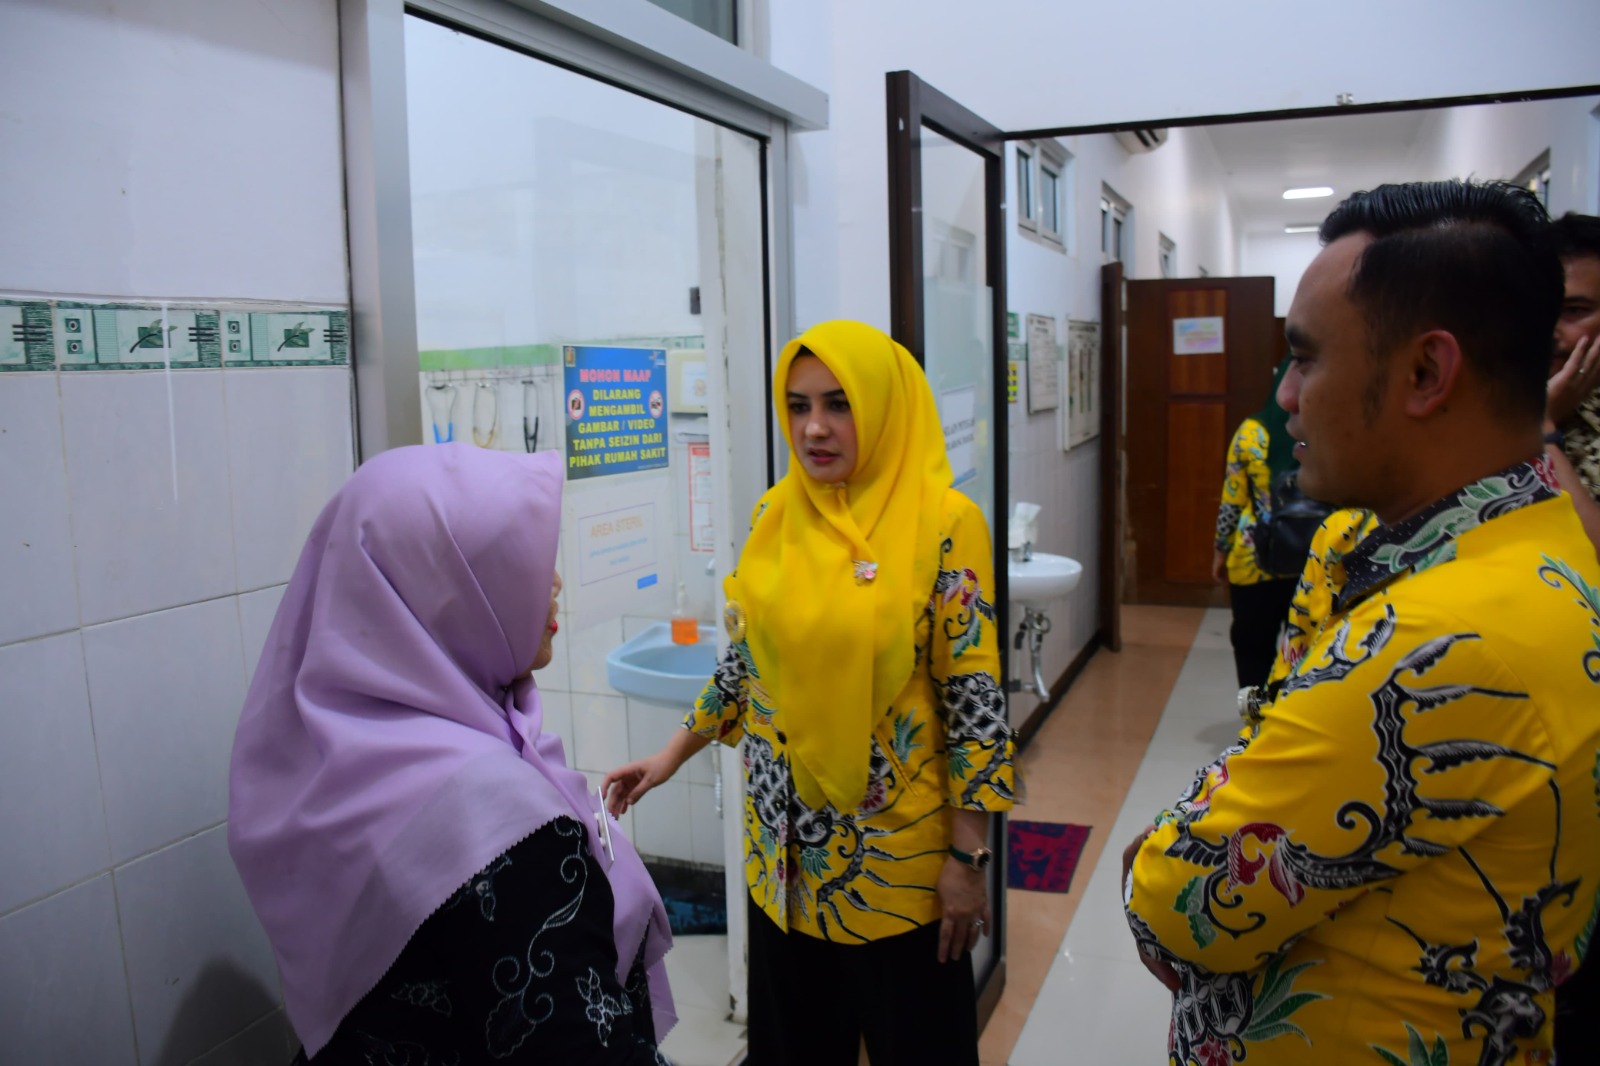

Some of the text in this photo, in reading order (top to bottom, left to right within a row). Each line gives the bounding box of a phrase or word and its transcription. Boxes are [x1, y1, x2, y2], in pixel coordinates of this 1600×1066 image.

[580, 369, 651, 382] MOHON MAAF
[593, 389, 641, 400] DILARANG
[589, 404, 645, 416] MENGAMBIL
[578, 420, 619, 433] GAMBAR
[627, 419, 655, 430] VIDEO
[573, 433, 662, 450] TANPA SEIZIN DARI
[569, 447, 666, 468] PIHAK RUMAH SAKIT
[591, 522, 614, 537] AREA
